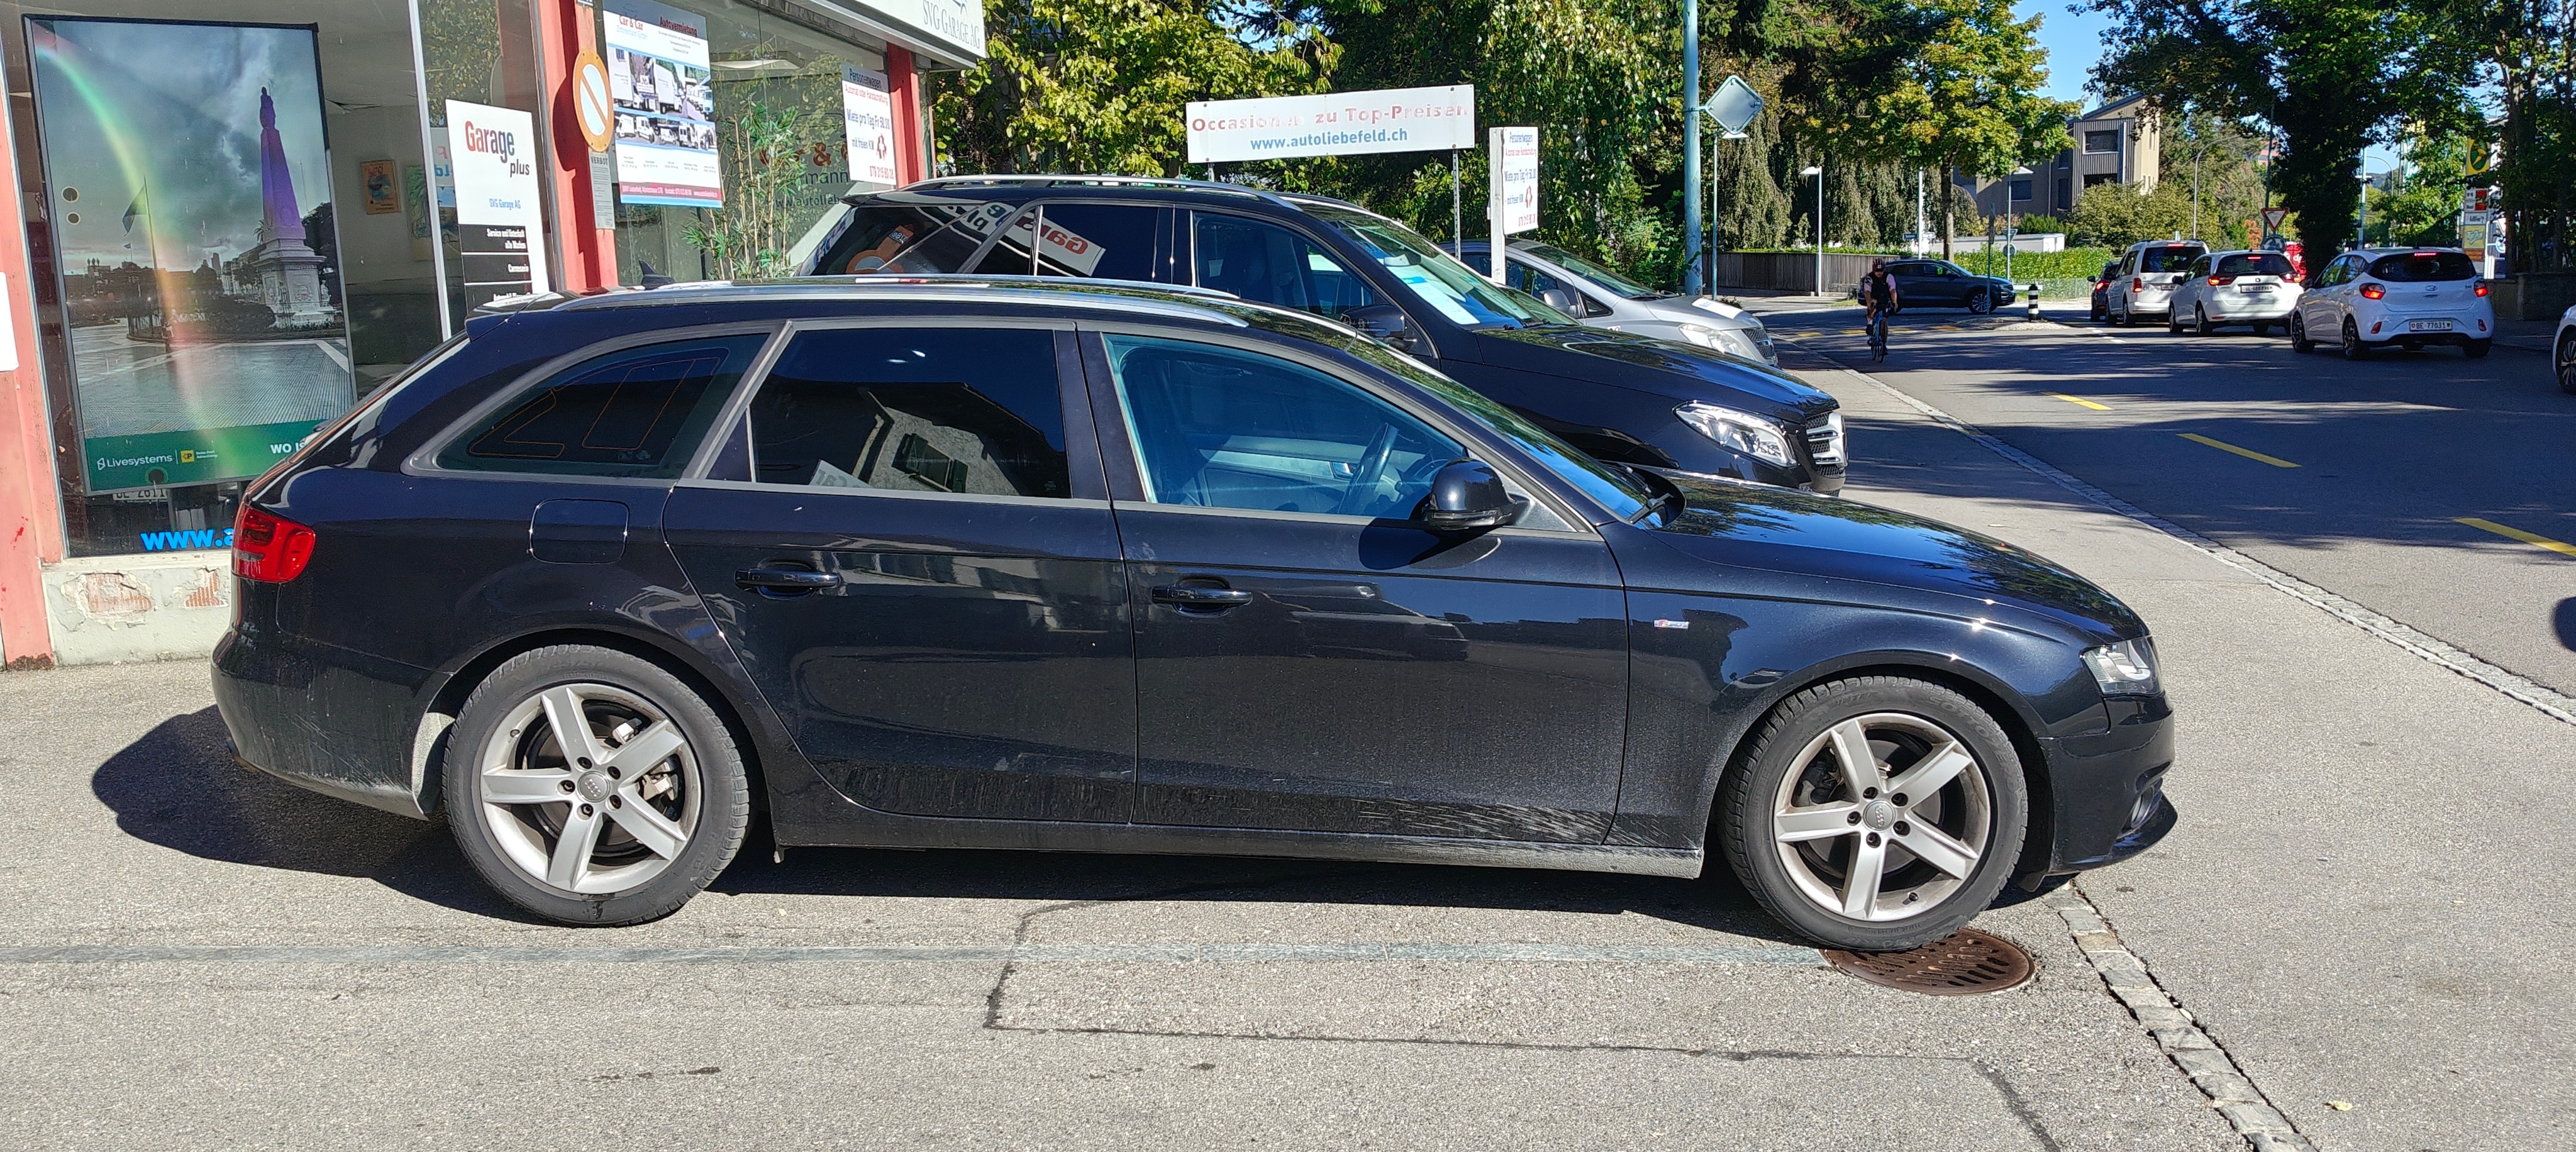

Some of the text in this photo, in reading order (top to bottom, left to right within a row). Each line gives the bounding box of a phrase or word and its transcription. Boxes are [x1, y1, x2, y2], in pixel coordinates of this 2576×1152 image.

[619, 15, 628, 26] Car
[635, 19, 643, 31] Car
[923, 0, 940, 30] SVG
[1315, 111, 1337, 124] zu
[1345, 104, 1468, 124] Top-Preisen
[465, 121, 514, 163] Garage
[1250, 128, 1407, 150] www.autoliebefeld.ch
[591, 155, 608, 166] VERBOT
[813, 142, 831, 166] &
[510, 158, 530, 178] plus
[270, 443, 291, 454] WO
[107, 454, 173, 468] Livesystems
